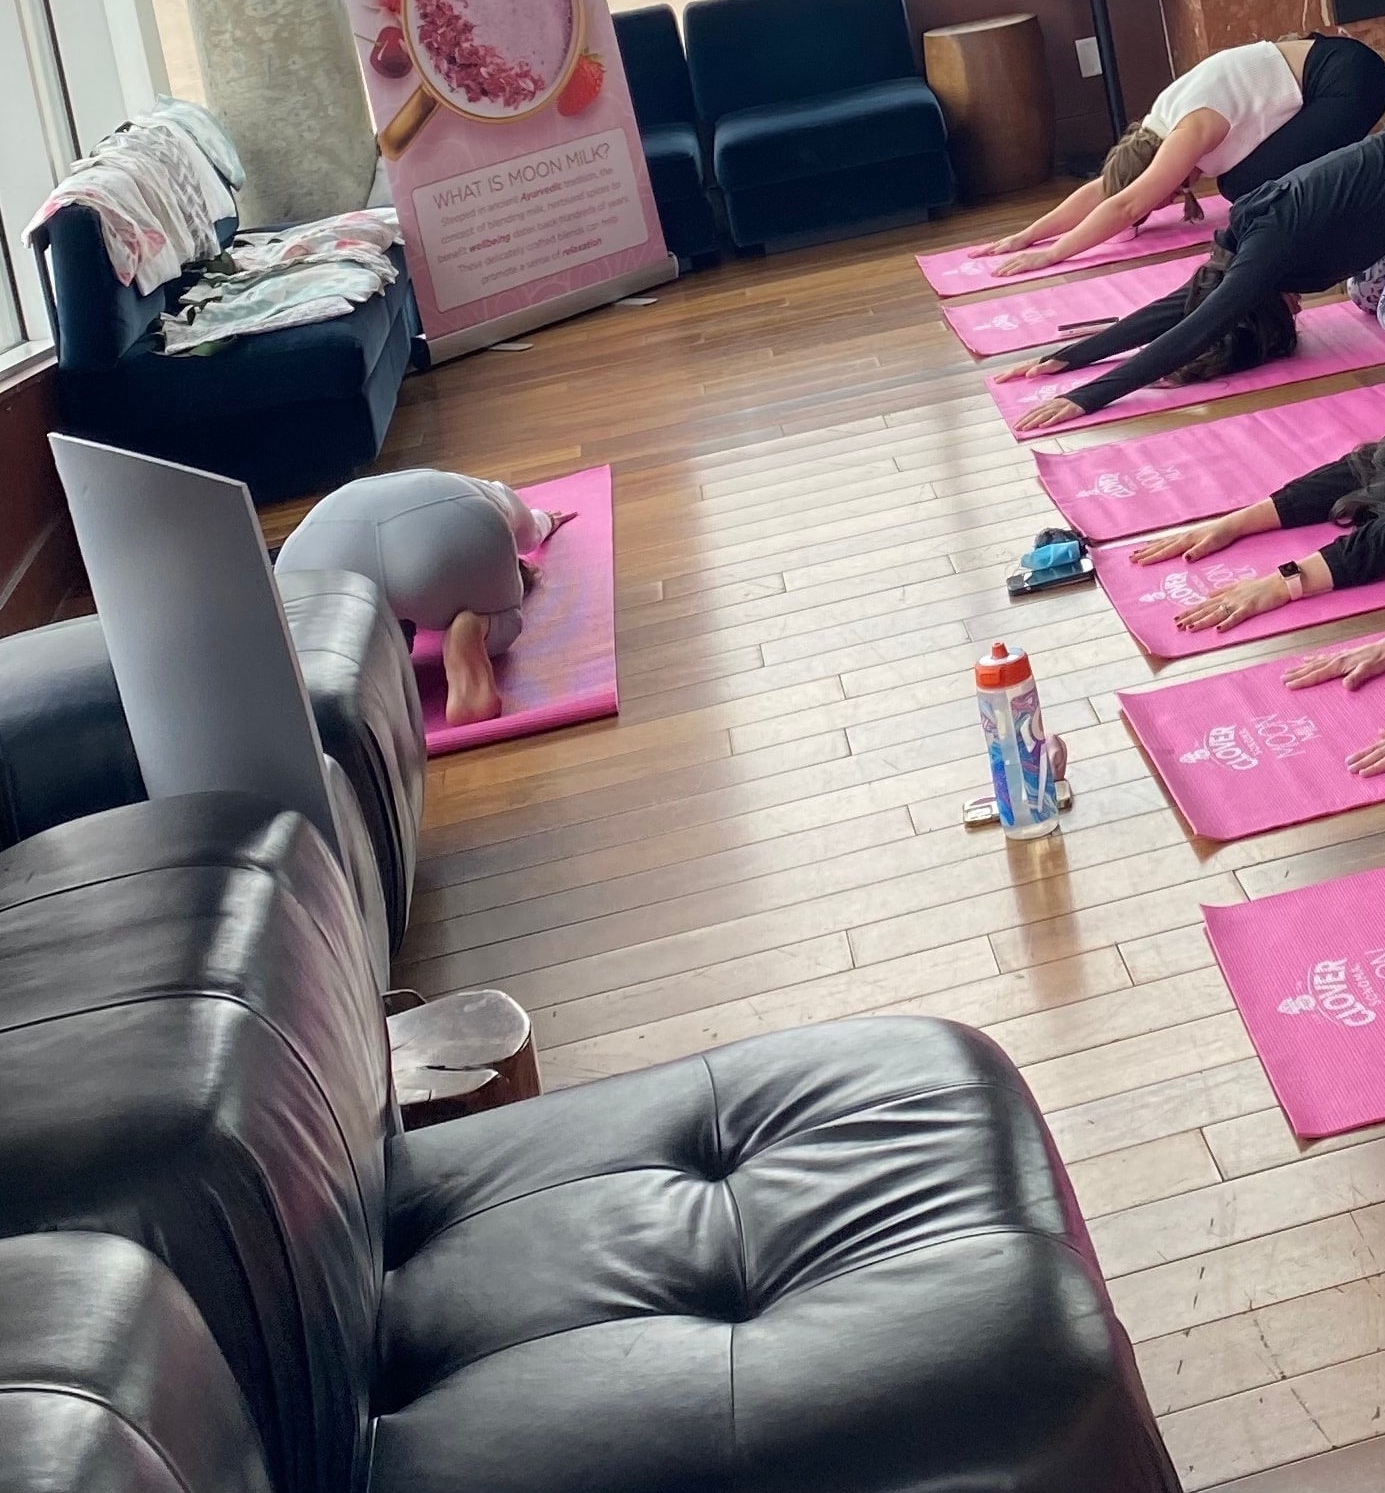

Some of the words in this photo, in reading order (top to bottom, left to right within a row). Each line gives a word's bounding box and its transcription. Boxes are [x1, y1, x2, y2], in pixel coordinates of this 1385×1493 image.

[433, 182, 483, 209] WHAT
[488, 175, 504, 193] IS
[508, 158, 562, 186] MOON
[566, 143, 611, 169] MILK?
[1208, 724, 1259, 771] CLOVER
[1313, 957, 1376, 1027] CLOVER
